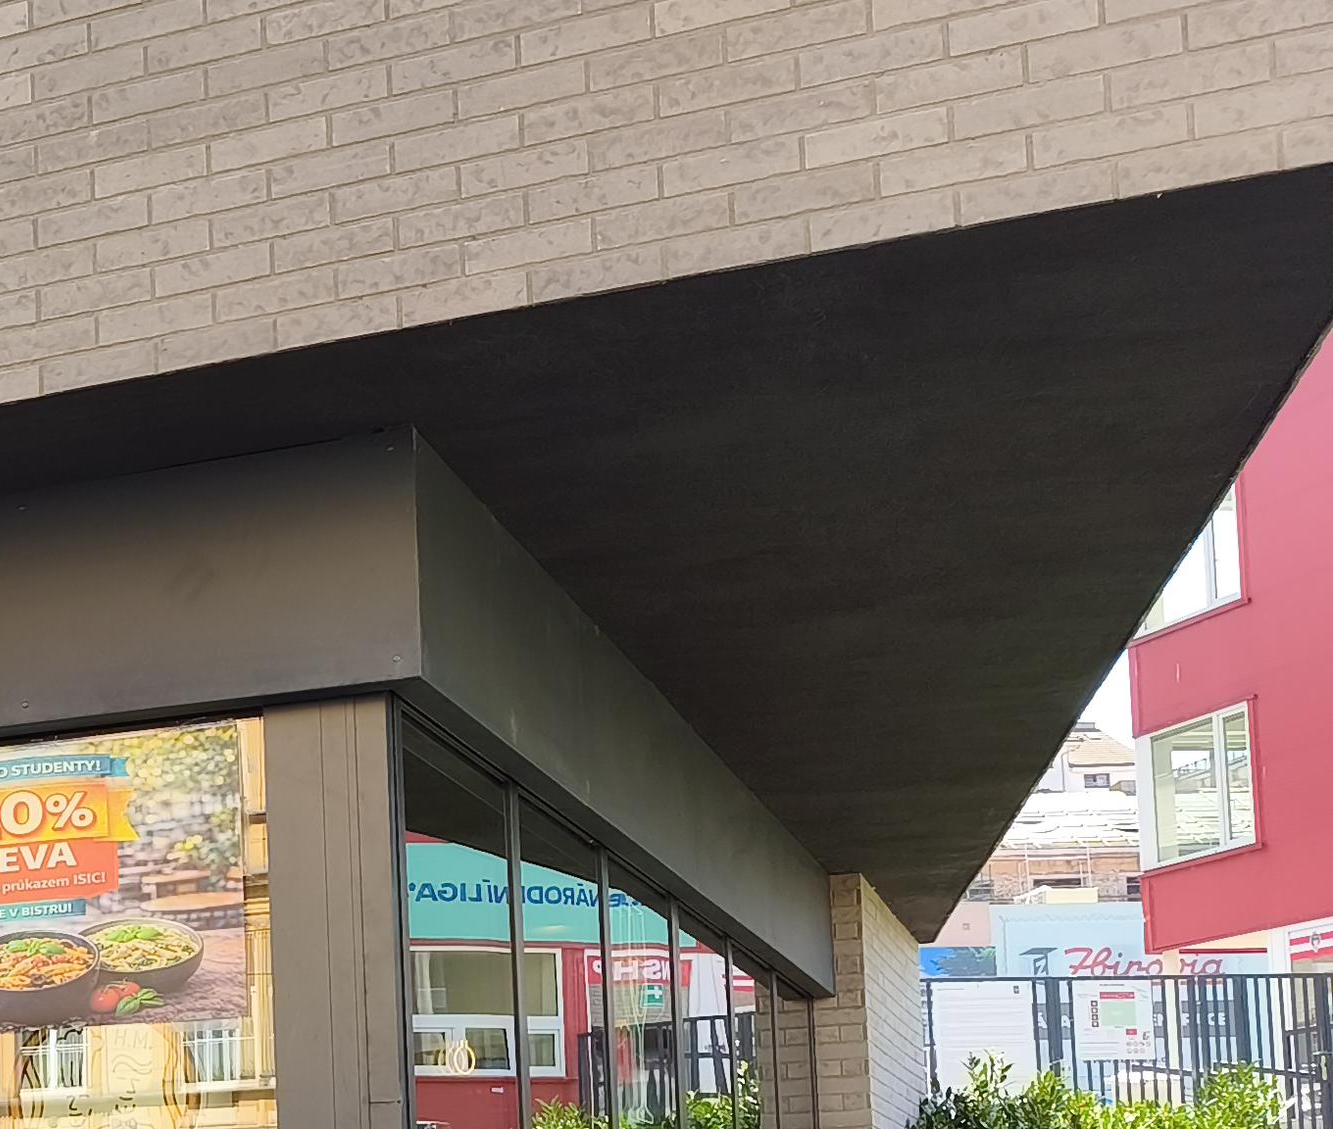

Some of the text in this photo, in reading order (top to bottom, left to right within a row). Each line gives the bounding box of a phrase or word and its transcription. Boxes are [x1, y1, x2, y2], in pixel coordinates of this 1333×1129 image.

[10, 759, 102, 777] STUDENTY!
[2, 874, 70, 895] průkazem
[73, 871, 107, 886] ISIC!
[9, 907, 19, 918] V
[21, 902, 73, 917] BISTRU!
